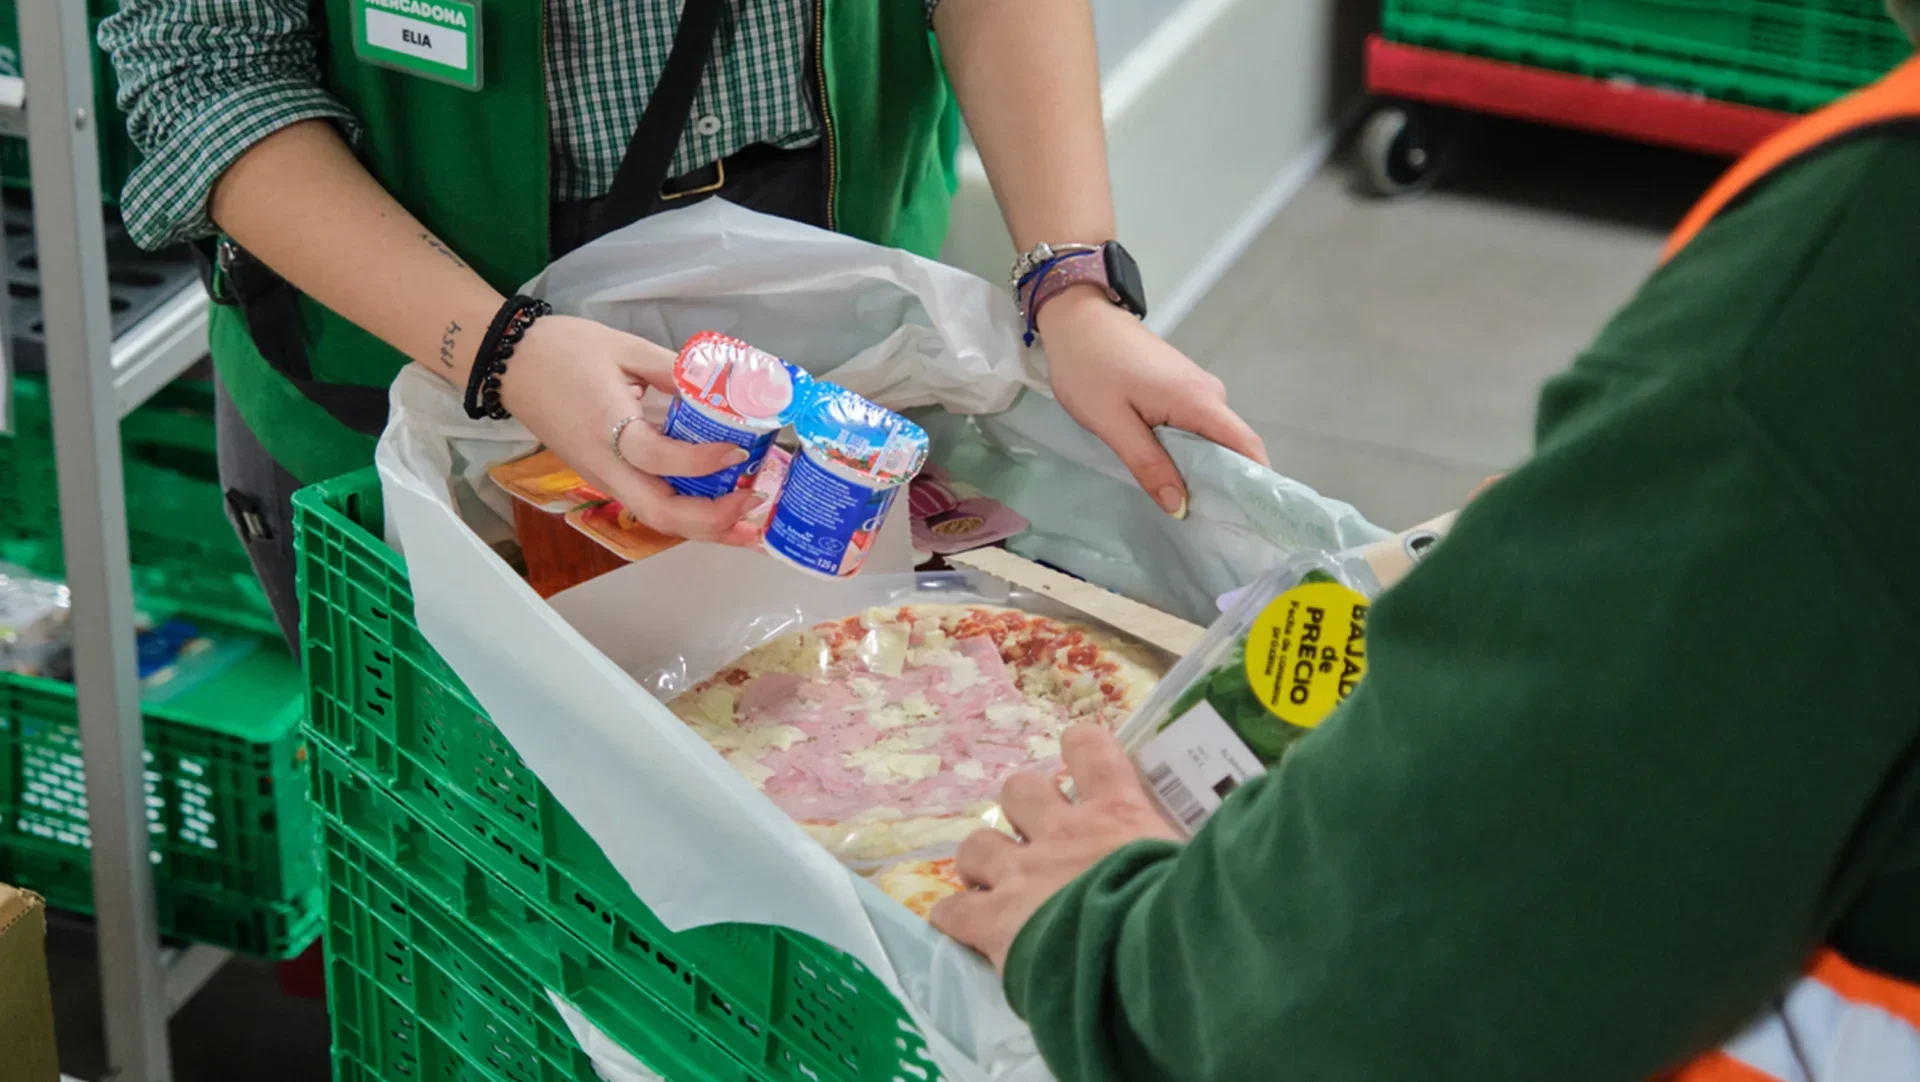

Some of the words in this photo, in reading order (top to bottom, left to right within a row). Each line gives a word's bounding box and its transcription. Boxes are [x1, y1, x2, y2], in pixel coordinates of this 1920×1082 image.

[402, 29, 432, 48] ELIA
[440, 320, 462, 368] 1954
[1285, 600, 1300, 635] Fecha
[1281, 637, 1292, 652] de
[1290, 606, 1325, 705] PRECIO
[1319, 645, 1339, 673] de
[1335, 604, 1368, 706] BAJAD
[1271, 654, 1287, 706] consumo
